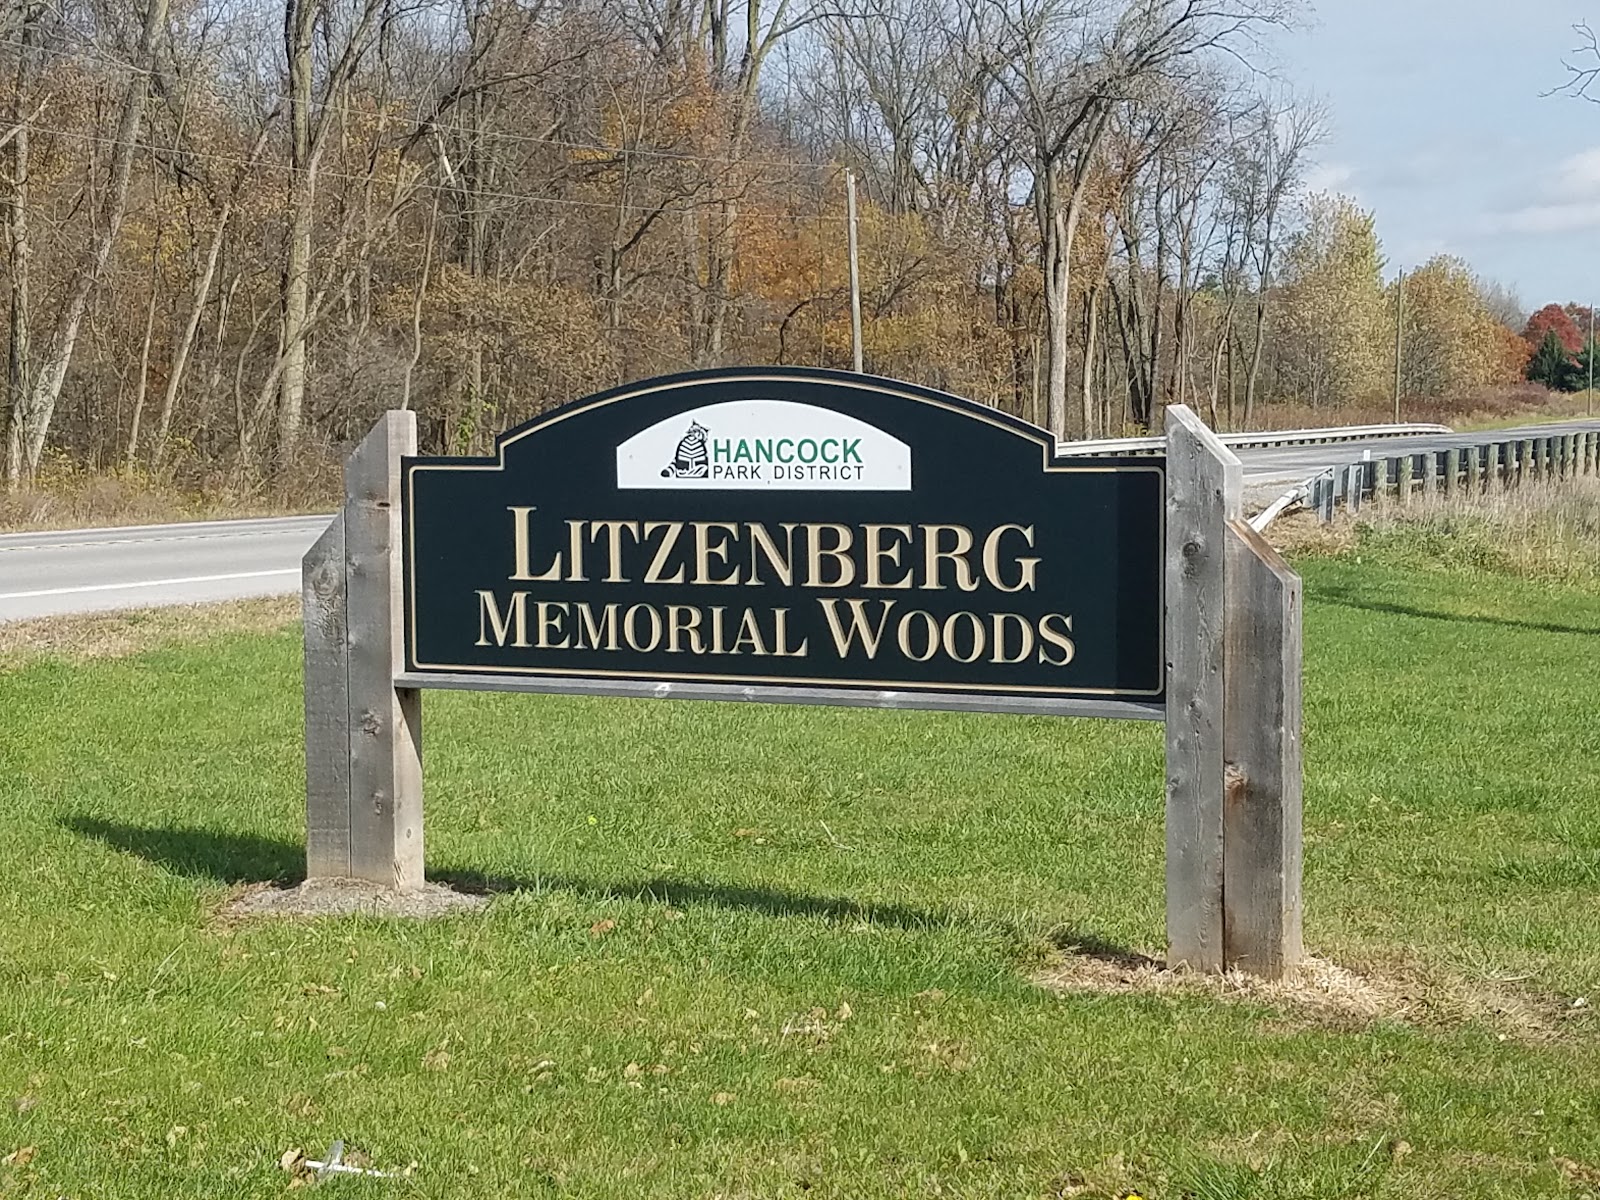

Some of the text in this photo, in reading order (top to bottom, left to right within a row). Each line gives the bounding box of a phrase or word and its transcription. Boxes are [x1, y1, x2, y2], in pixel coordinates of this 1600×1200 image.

[713, 438, 862, 464] HANCOCK
[713, 465, 864, 480] PARK DISTRICT
[507, 505, 1043, 593] LITZENBERG
[474, 590, 1075, 666] MEMORIAL WOODS
